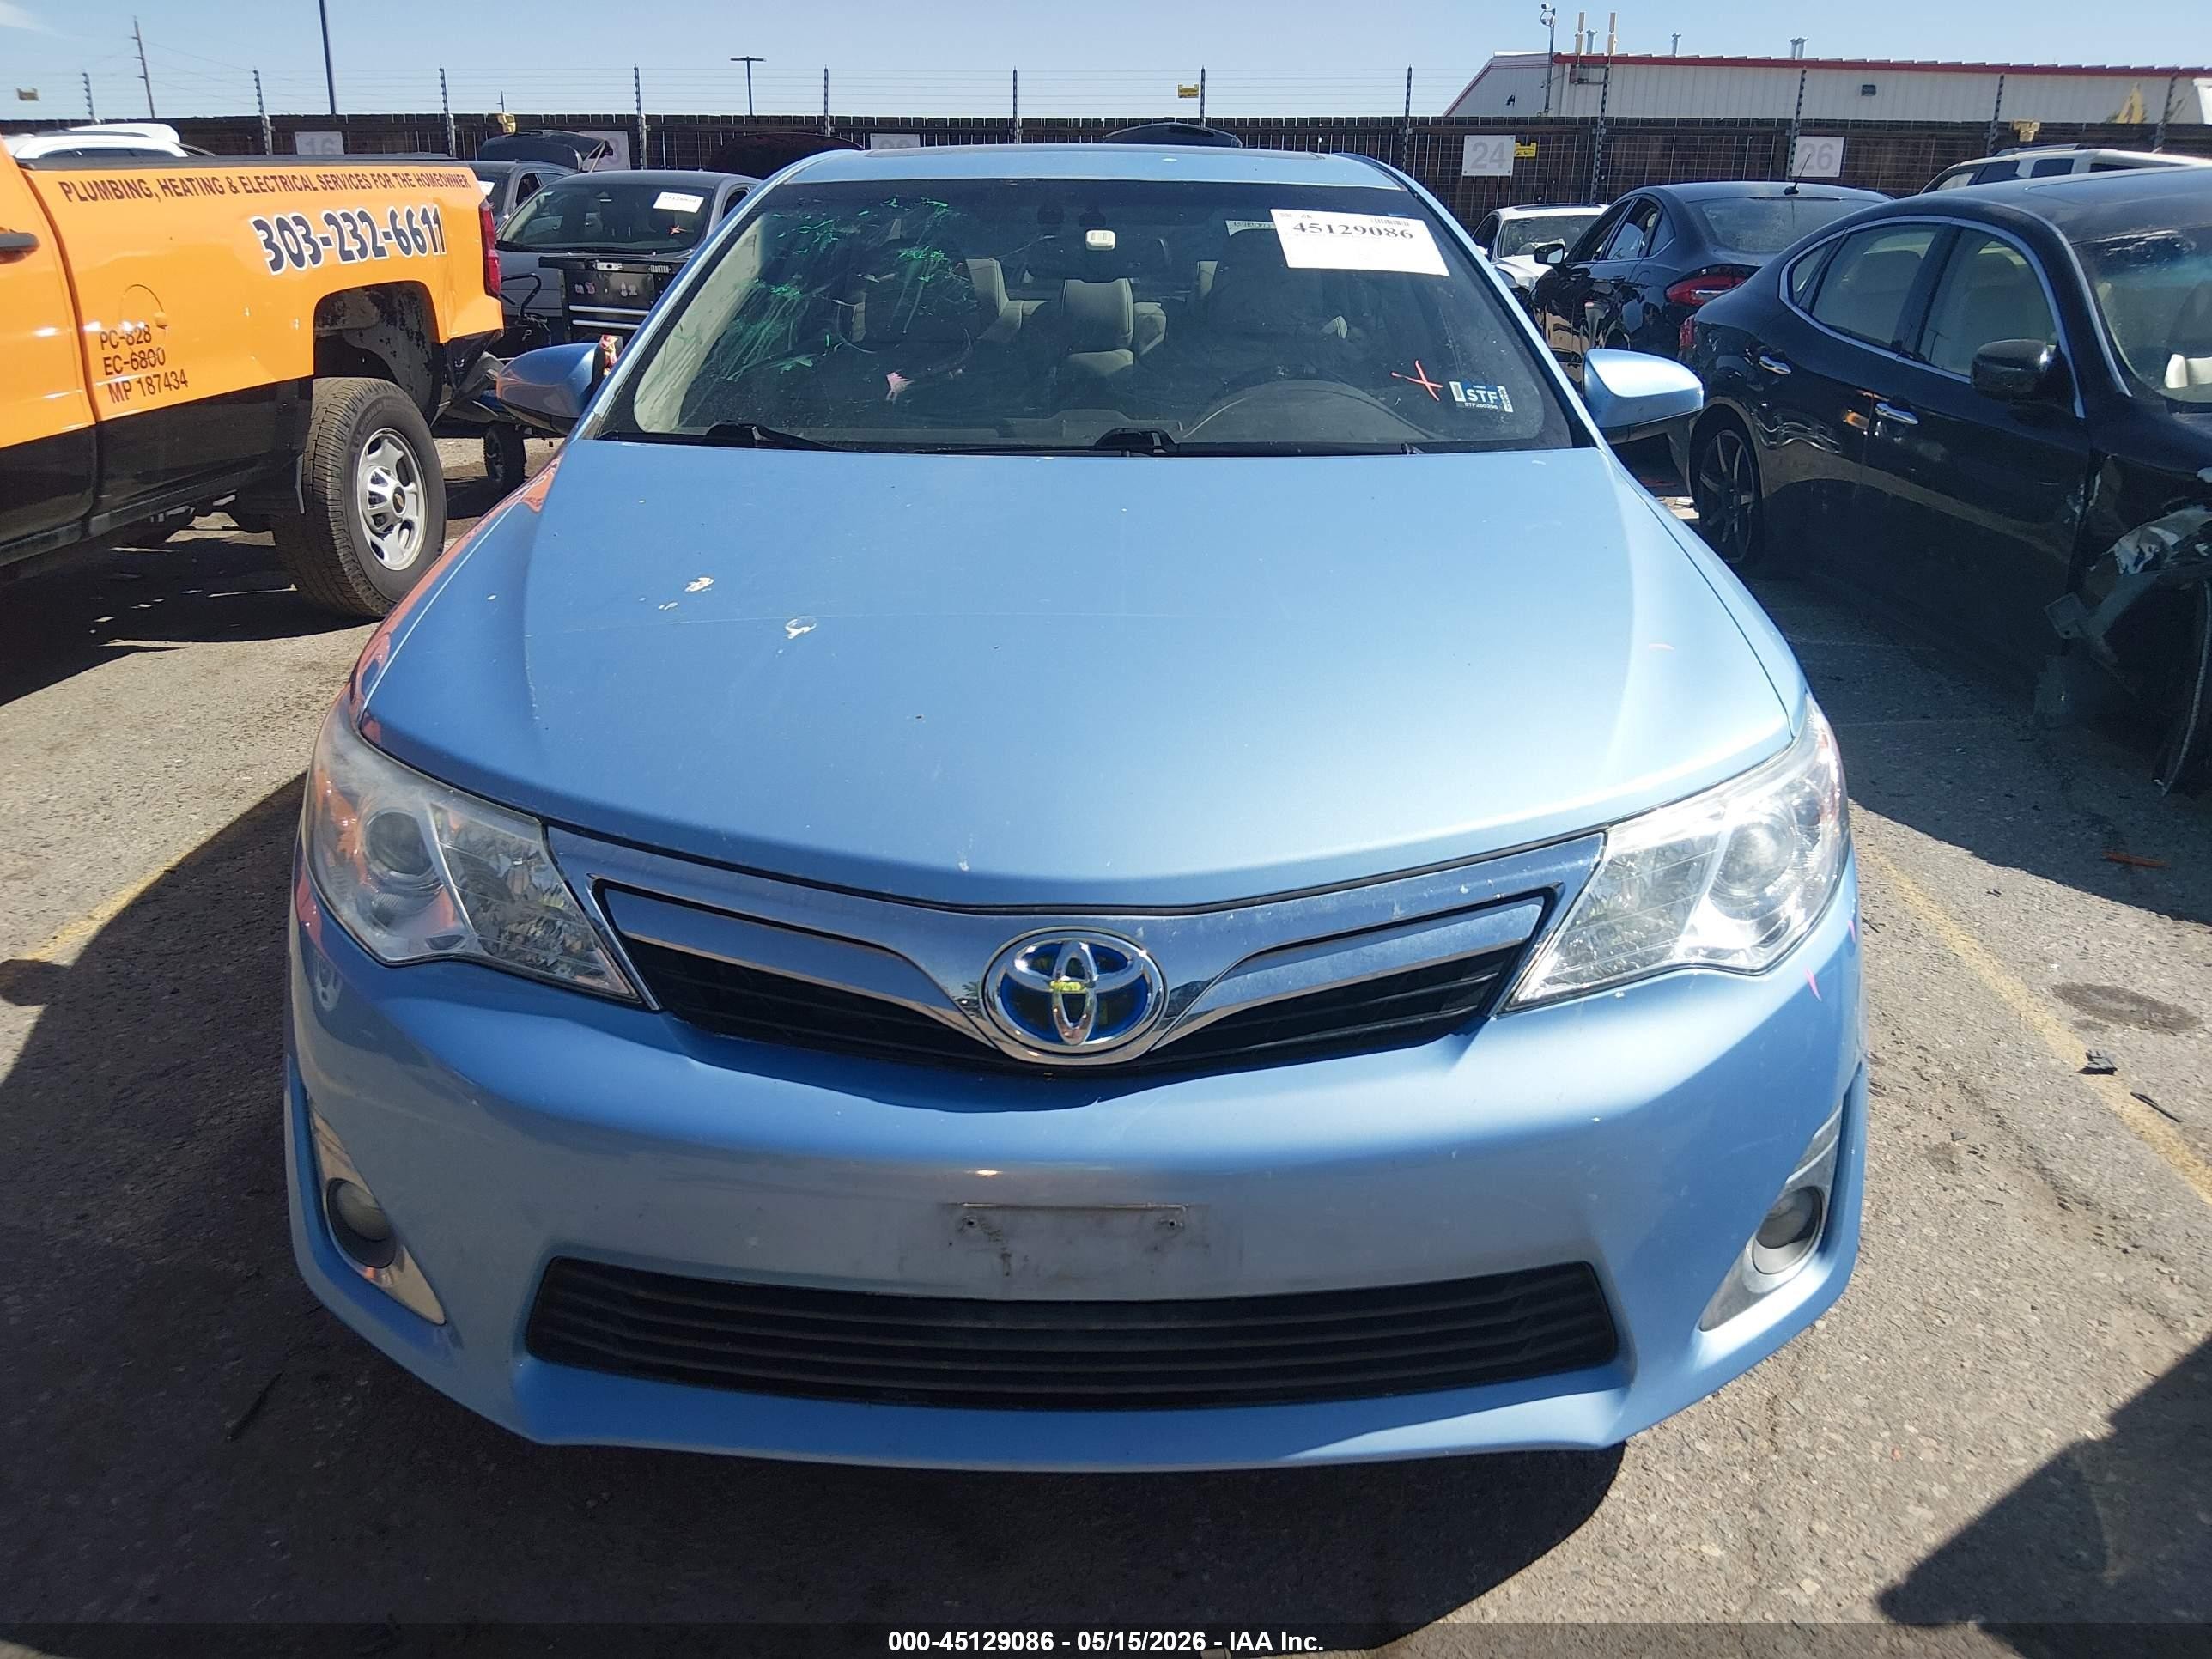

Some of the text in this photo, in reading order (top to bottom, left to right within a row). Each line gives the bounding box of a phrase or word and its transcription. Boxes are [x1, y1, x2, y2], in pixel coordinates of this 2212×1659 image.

[1470, 142, 1507, 169] 24
[1796, 143, 1834, 170] 26
[58, 173, 471, 202] PLUMBING, HEATING & ELECTRICAL SERVICES FOR THE HOMEOWNER
[251, 206, 446, 273] 303-232-6611
[1292, 222, 1414, 240] 45129086
[100, 325, 152, 351] PC-828
[103, 347, 166, 376] EC-6800
[107, 368, 189, 404] MP 187434
[1466, 388, 1498, 404] STF
